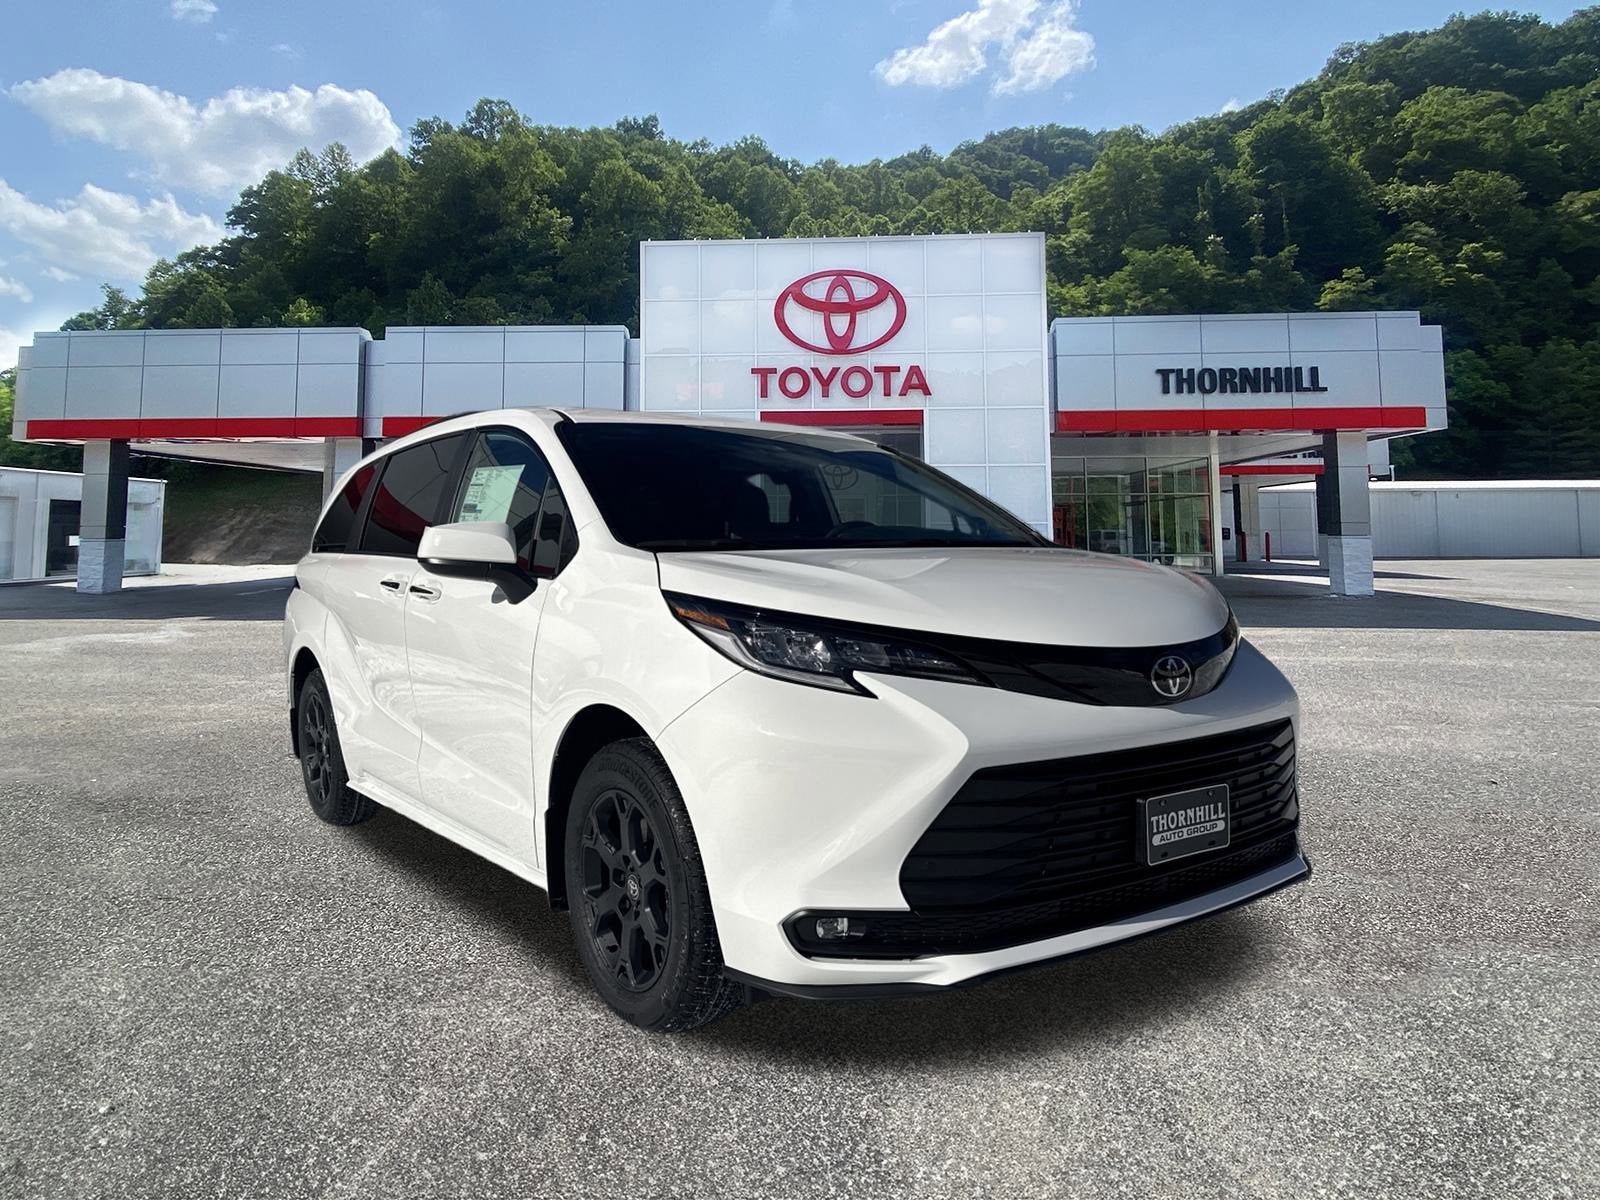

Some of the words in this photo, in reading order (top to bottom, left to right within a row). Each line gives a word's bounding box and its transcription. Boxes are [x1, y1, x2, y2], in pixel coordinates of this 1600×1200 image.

[751, 365, 932, 398] TOYOTA
[1155, 366, 1328, 394] THORNHILL
[1150, 802, 1226, 833] THORNHILL
[1159, 830, 1184, 843] AUTO
[1186, 822, 1218, 836] GROUP
